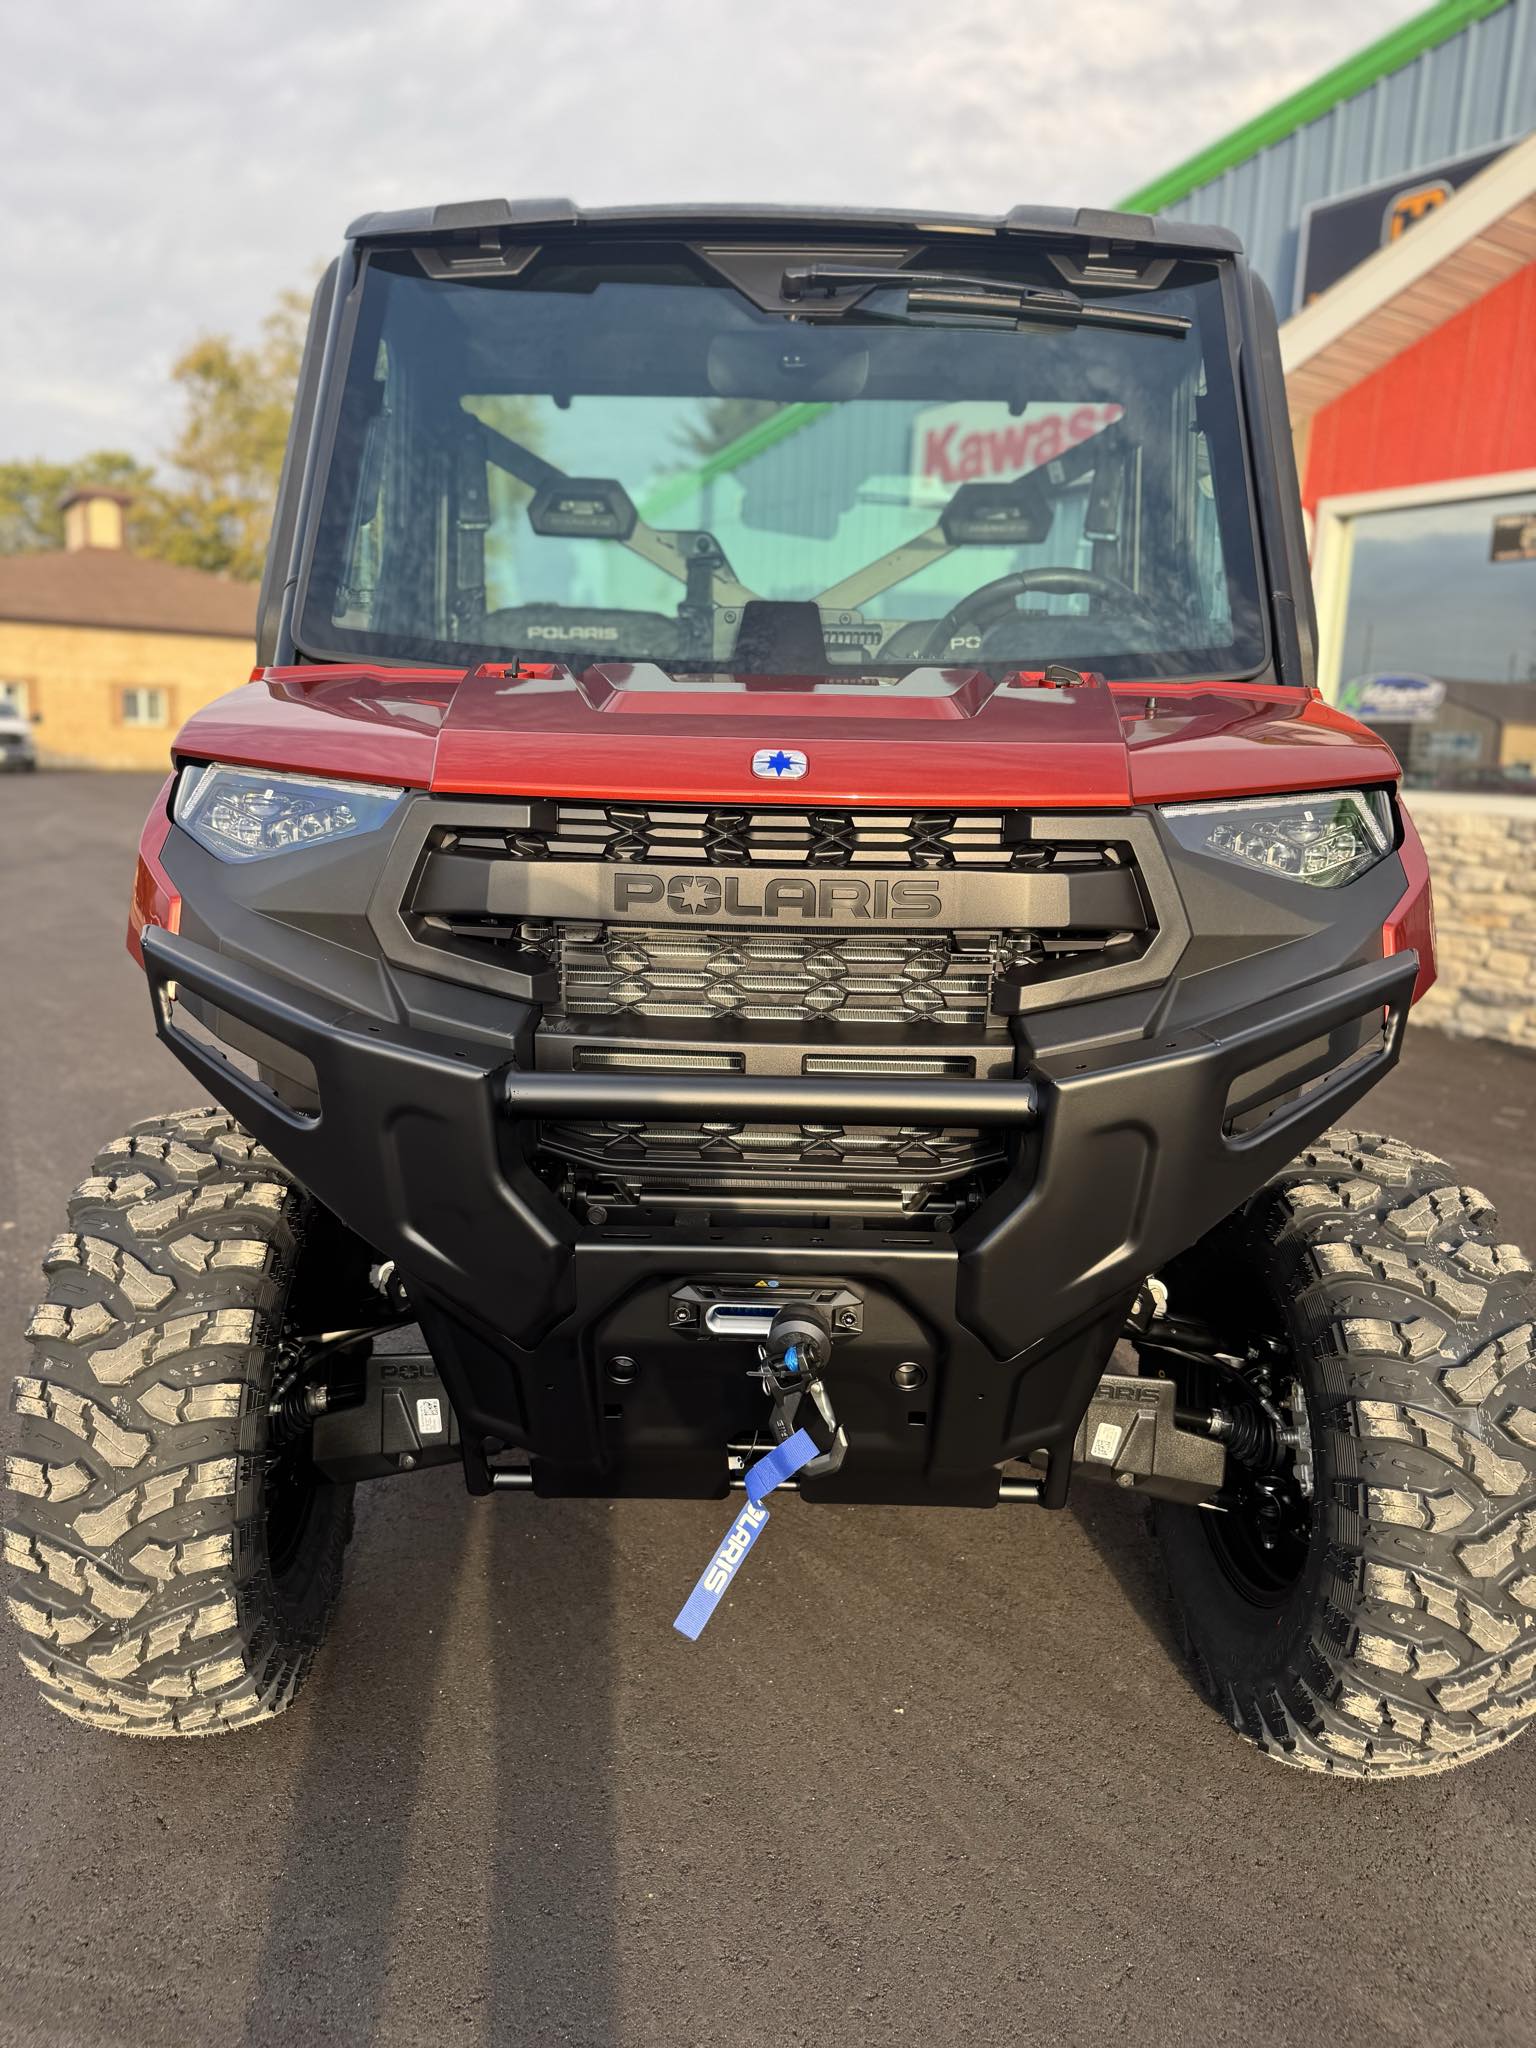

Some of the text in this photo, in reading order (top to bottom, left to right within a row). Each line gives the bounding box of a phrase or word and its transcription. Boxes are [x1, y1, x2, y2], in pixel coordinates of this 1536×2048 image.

[527, 625, 619, 640] POLARIS
[613, 872, 943, 920] POLARIS
[381, 1364, 437, 1380] POL
